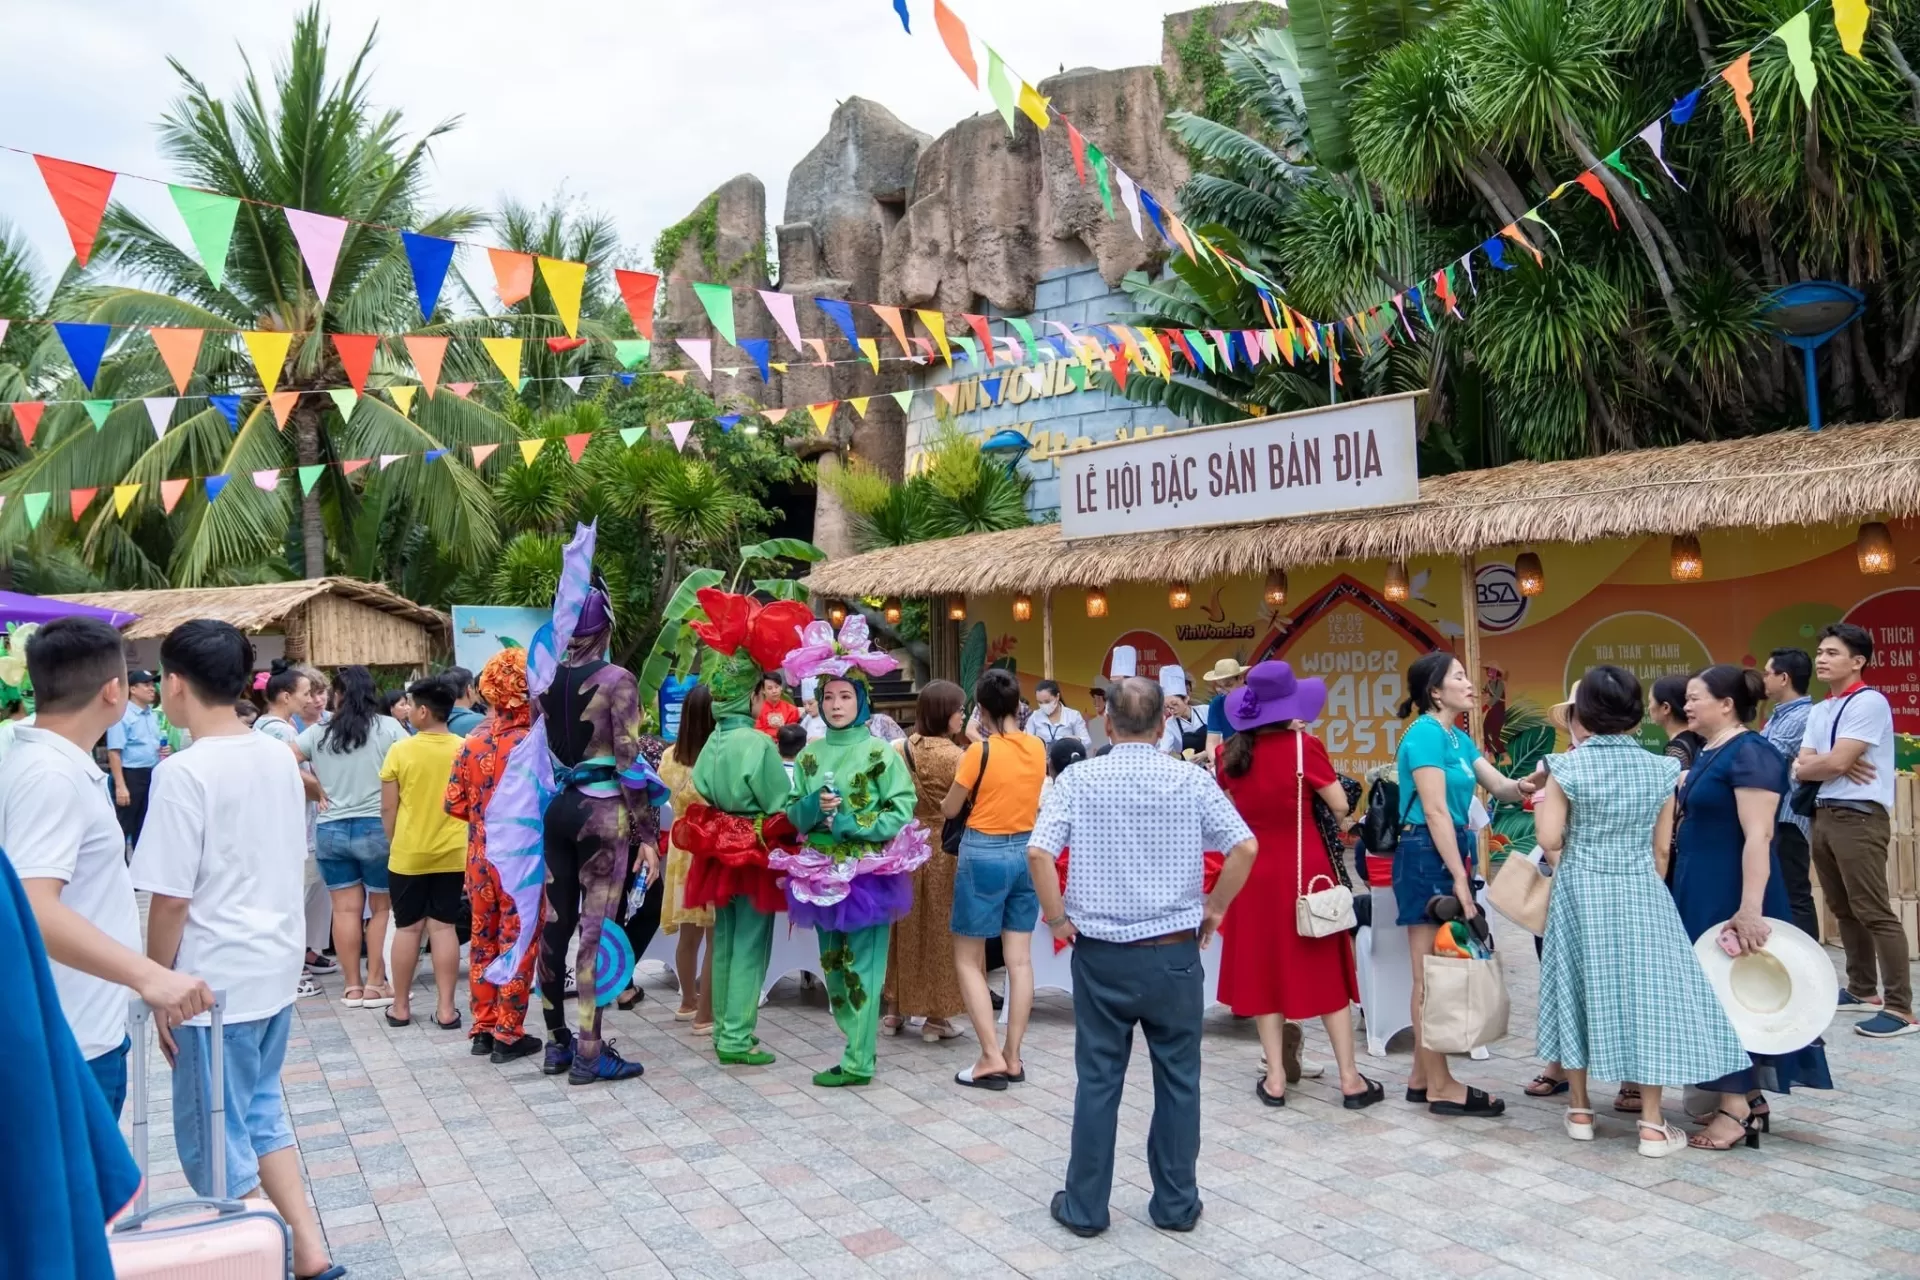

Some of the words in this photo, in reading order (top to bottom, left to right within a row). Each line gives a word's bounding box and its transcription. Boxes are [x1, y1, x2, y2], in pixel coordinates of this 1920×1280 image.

[1076, 463, 1097, 514] LỄ
[1106, 461, 1142, 515] HỘI
[1151, 454, 1198, 509] ĐẶC
[1208, 442, 1257, 498] SẢN
[1268, 432, 1322, 490] BẢN
[1333, 429, 1383, 487] ĐỊA
[1476, 582, 1520, 604] BSA
[1176, 622, 1255, 640] VinWonders
[1328, 633, 1365, 644] 2023
[1312, 673, 1402, 724] AIR
